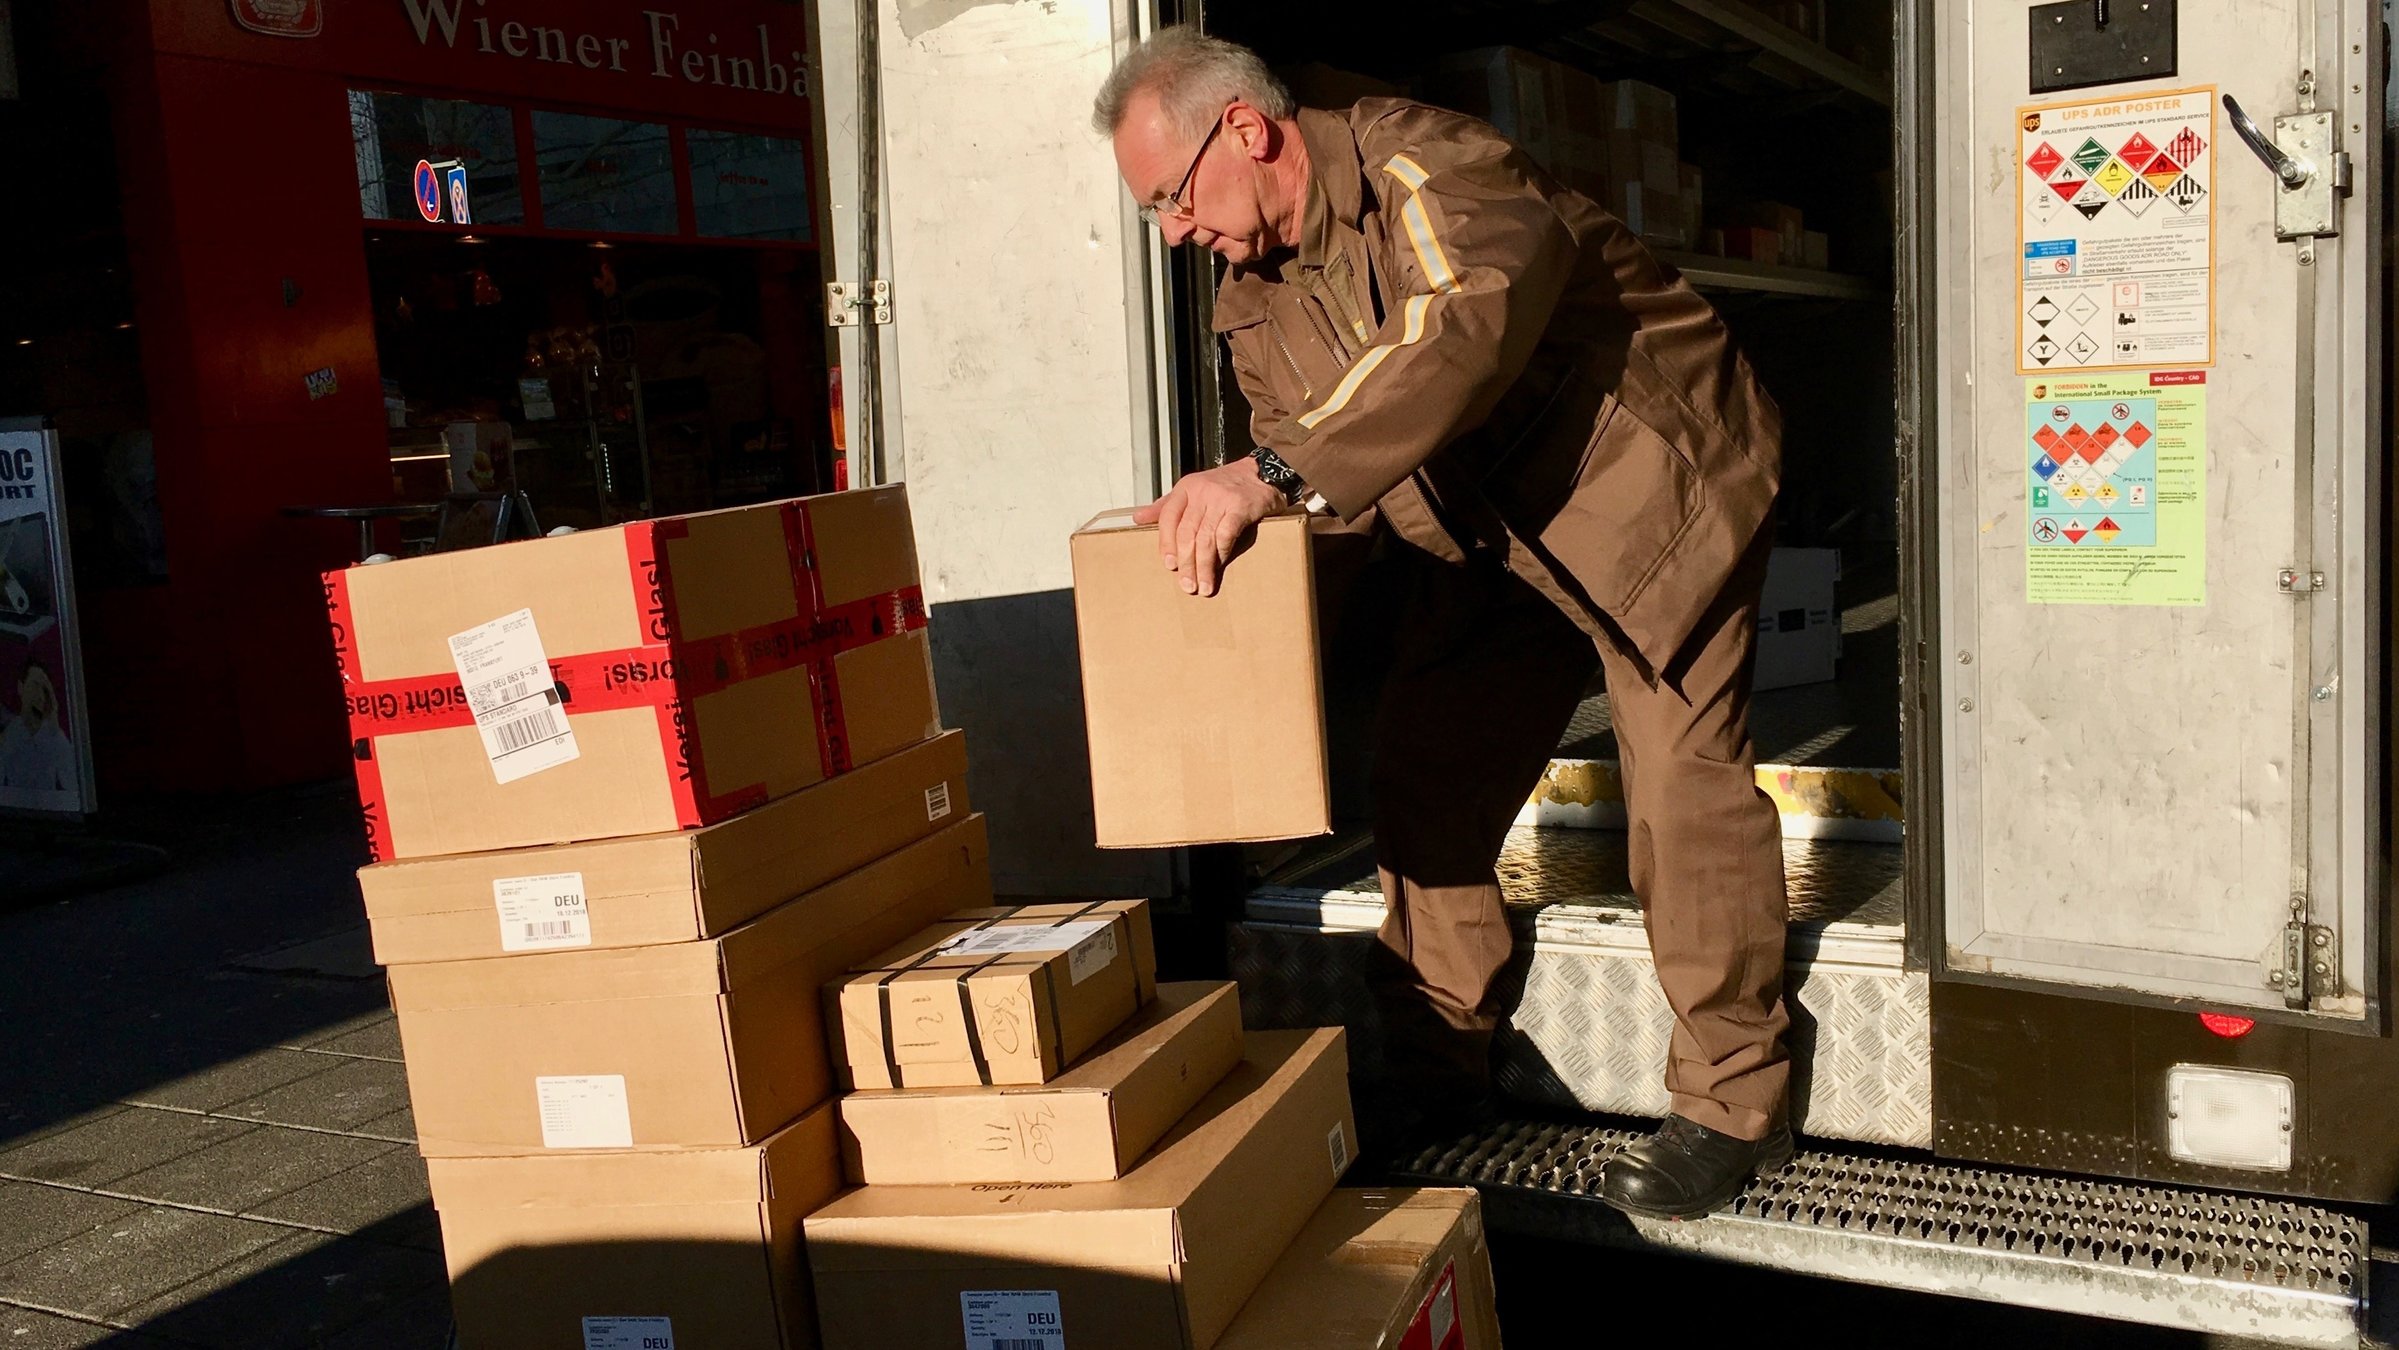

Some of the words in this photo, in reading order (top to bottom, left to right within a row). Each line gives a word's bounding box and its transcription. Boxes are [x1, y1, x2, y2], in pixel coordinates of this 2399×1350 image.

[400, 0, 630, 72] Wiener
[2062, 109, 2088, 121] UPS
[2093, 105, 2121, 118] ADR
[2125, 99, 2181, 114] POSTER
[2157, 114, 2186, 123] STANDARD
[2187, 112, 2210, 120] SERVICE
[2024, 117, 2040, 131] ups
[2040, 345, 2048, 355] Y
[2165, 375, 2184, 383] Country
[2054, 390, 2092, 398] International
[2112, 389, 2138, 397] Package
[493, 678, 506, 689] DEU
[507, 673, 519, 684] 063
[479, 715, 489, 723] UPS
[490, 704, 517, 720] STANDARD
[554, 894, 580, 907] DEU
[971, 1183, 1022, 1192] Open
[1026, 1182, 1072, 1190] Here
[1028, 1313, 1055, 1324] DEU
[643, 1338, 668, 1349] DEU
